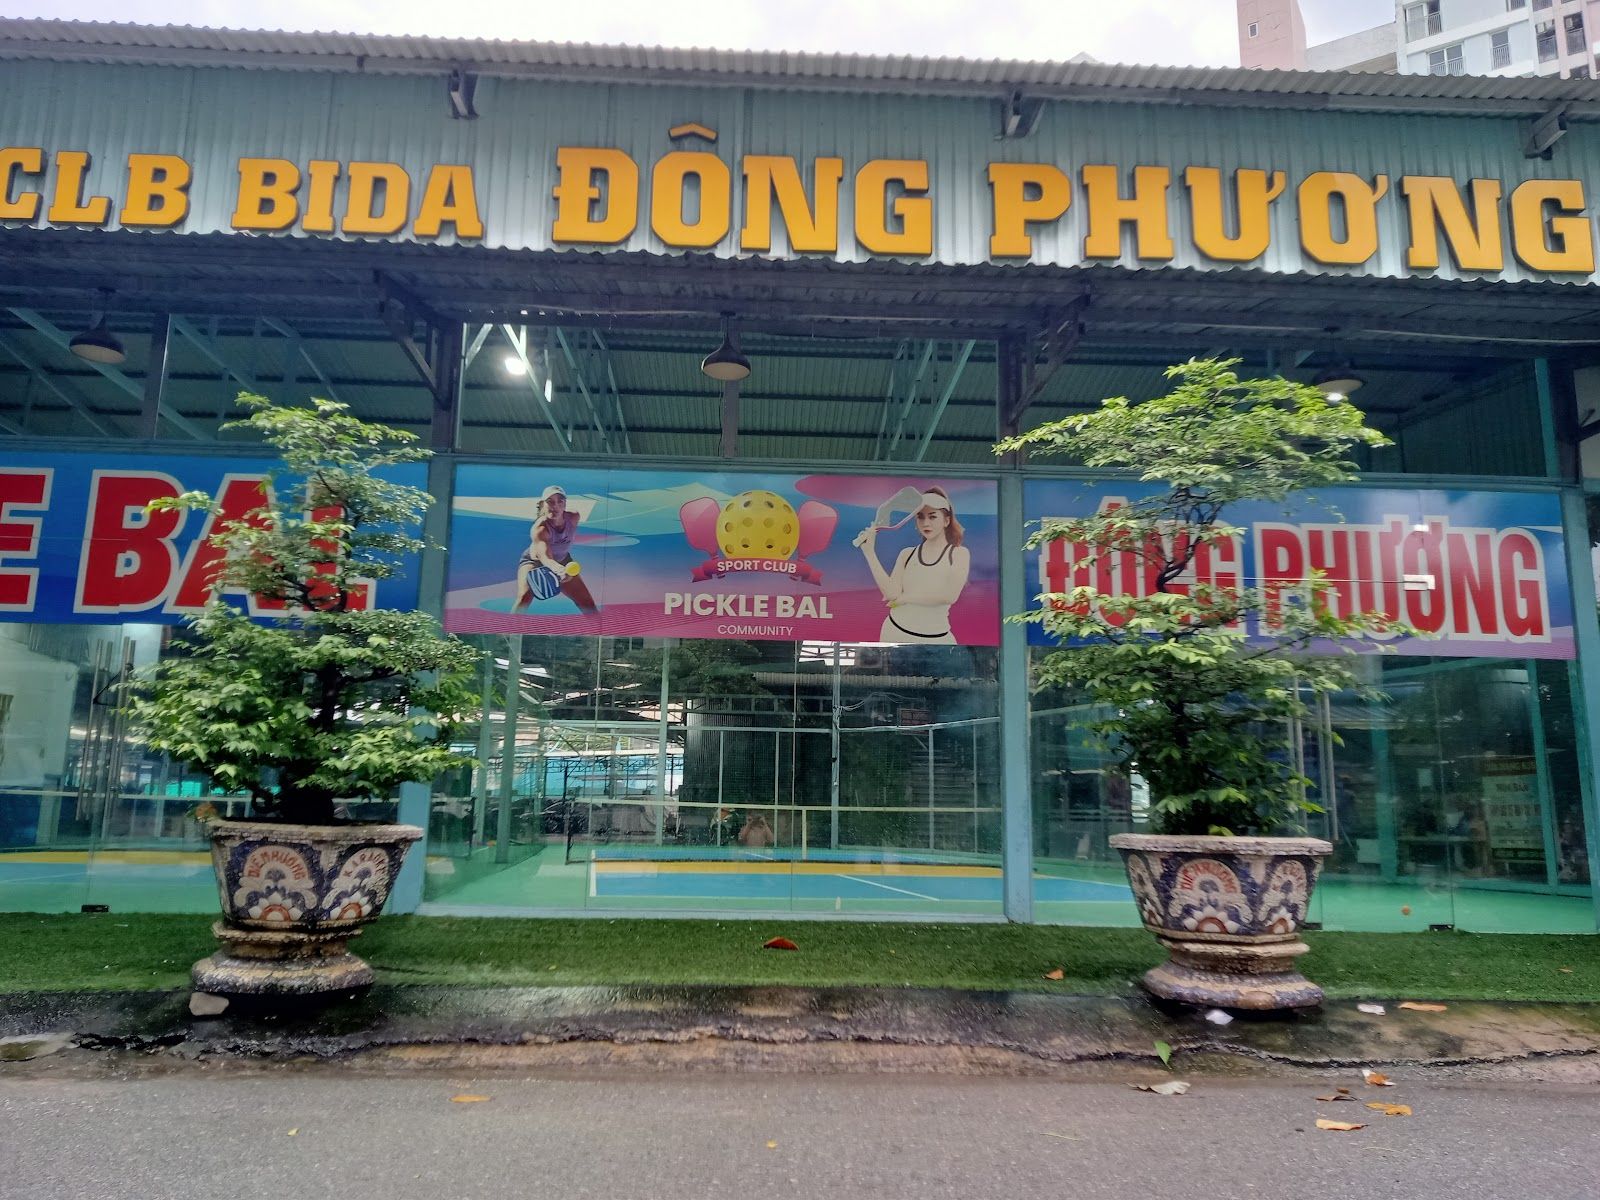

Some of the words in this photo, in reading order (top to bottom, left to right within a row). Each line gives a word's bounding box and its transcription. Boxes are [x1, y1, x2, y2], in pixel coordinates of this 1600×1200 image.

[0, 147, 192, 228] CLB
[230, 157, 484, 240] BIDA
[551, 122, 933, 257] ĐÔNG
[988, 161, 1596, 276] PHƯƠNG
[717, 560, 760, 572] SPORT
[763, 560, 797, 574] CLUB
[1252, 514, 1552, 643] PHƯƠNG
[664, 592, 769, 618] PICKLE
[776, 595, 833, 619] BAL
[717, 624, 794, 636] COMMUNITY
